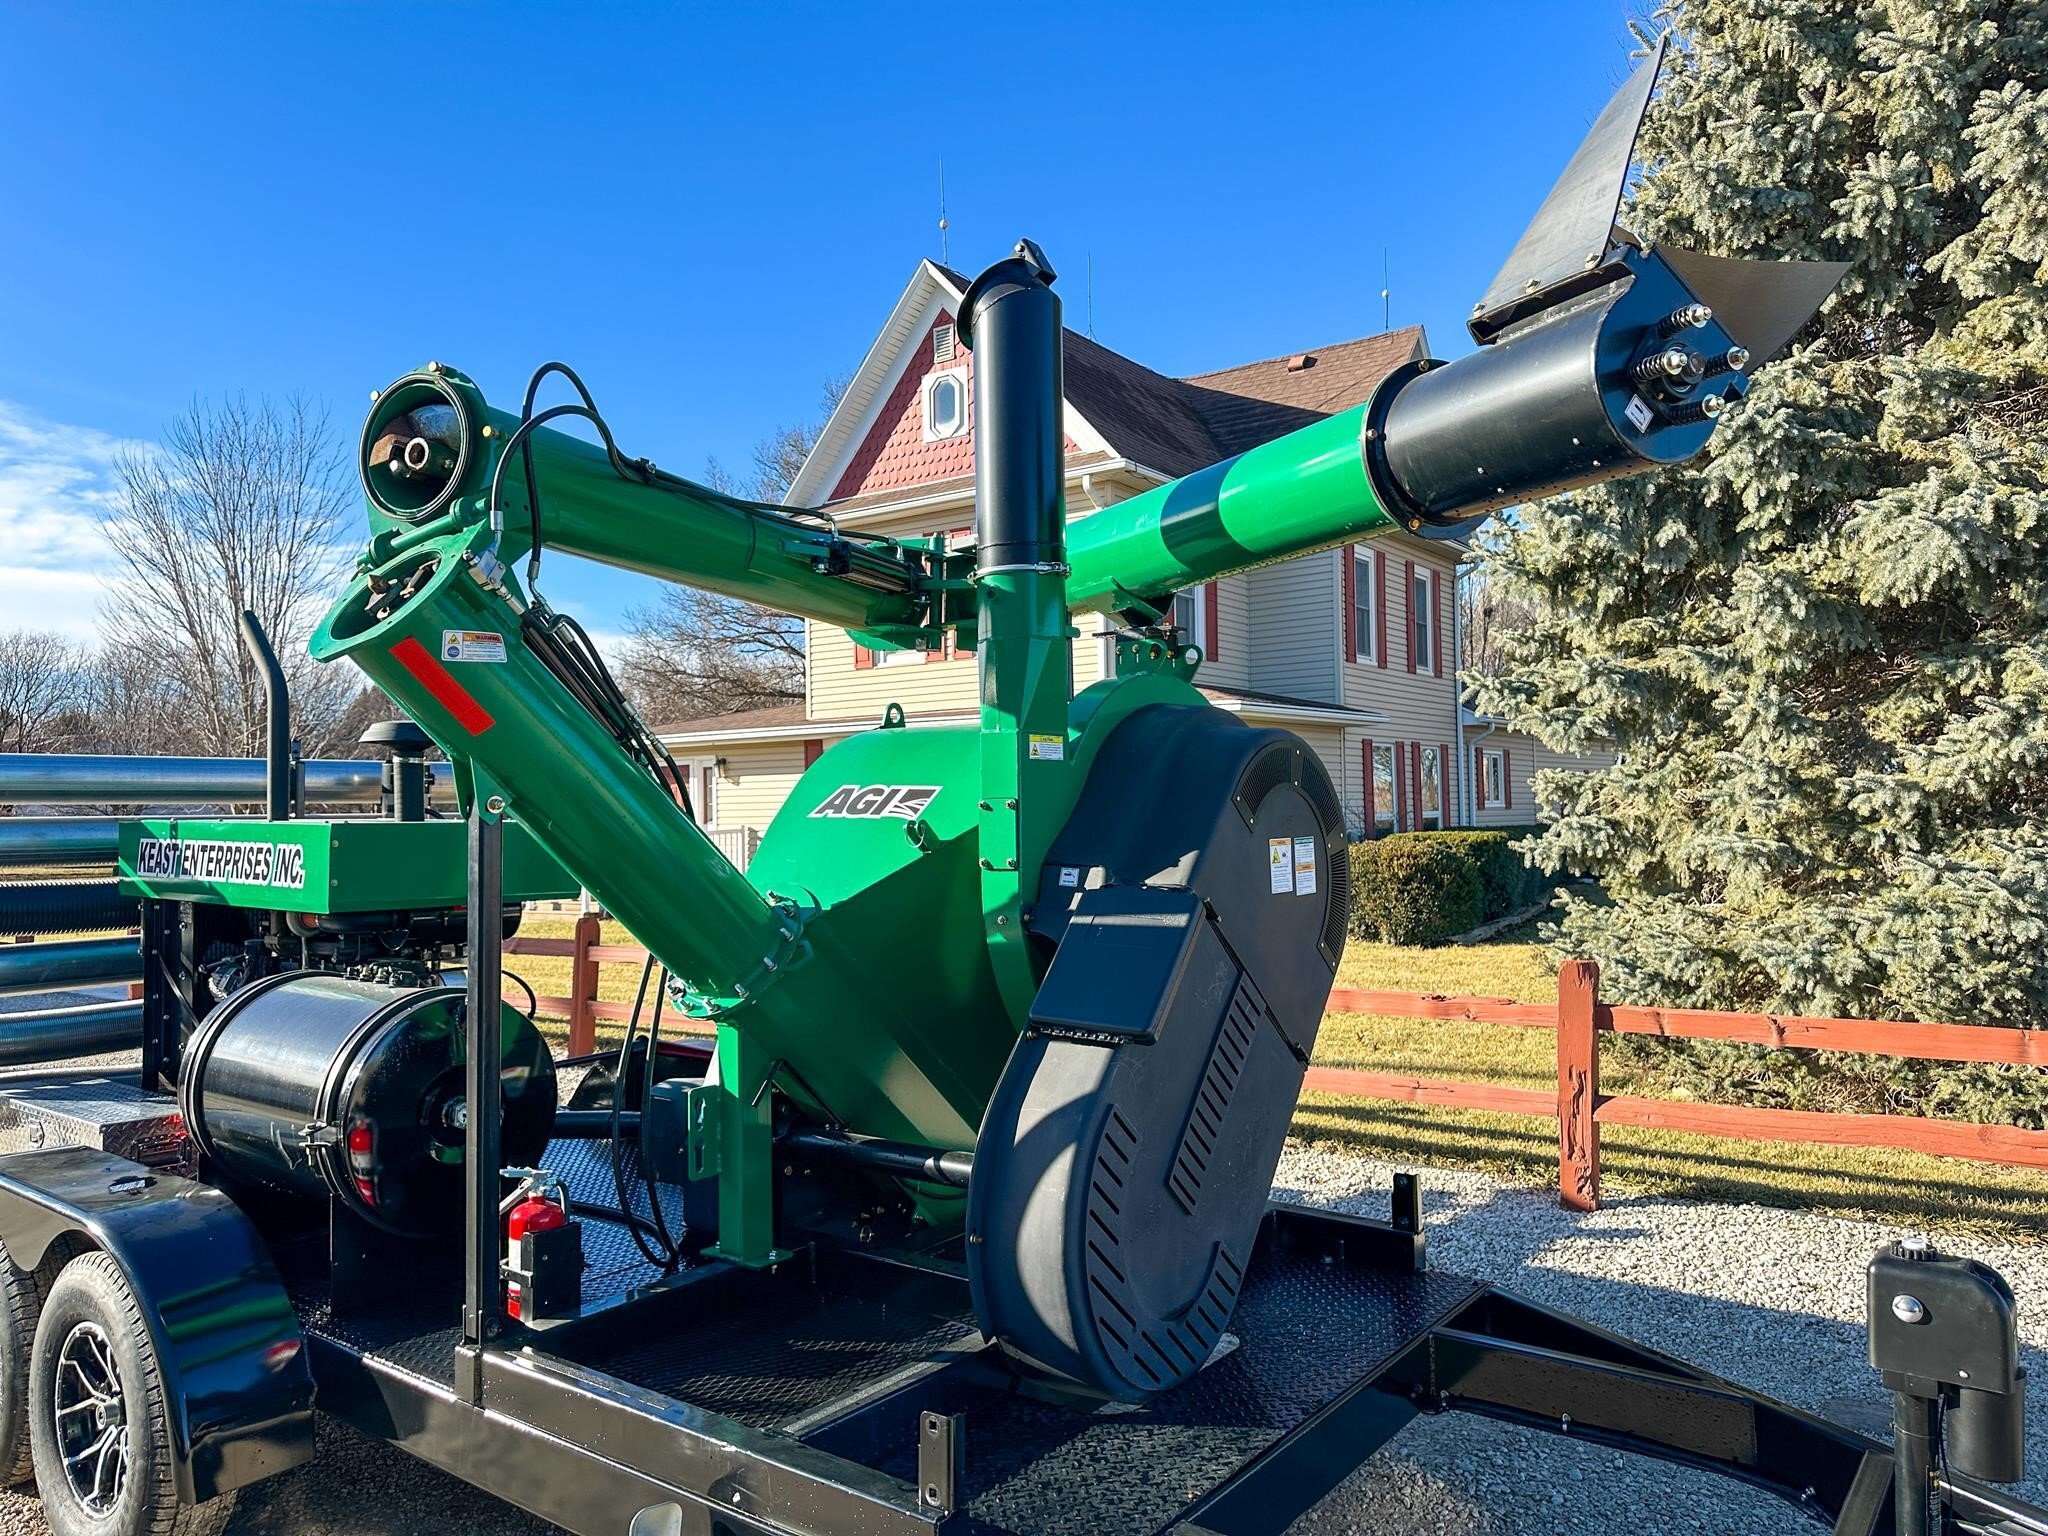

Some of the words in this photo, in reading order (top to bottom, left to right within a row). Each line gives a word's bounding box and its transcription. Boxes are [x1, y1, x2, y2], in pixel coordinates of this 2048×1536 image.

[813, 787, 902, 816] AGI
[138, 840, 180, 875] KEAST
[181, 843, 272, 882] ENTERPRISES
[273, 847, 304, 884] INC.
